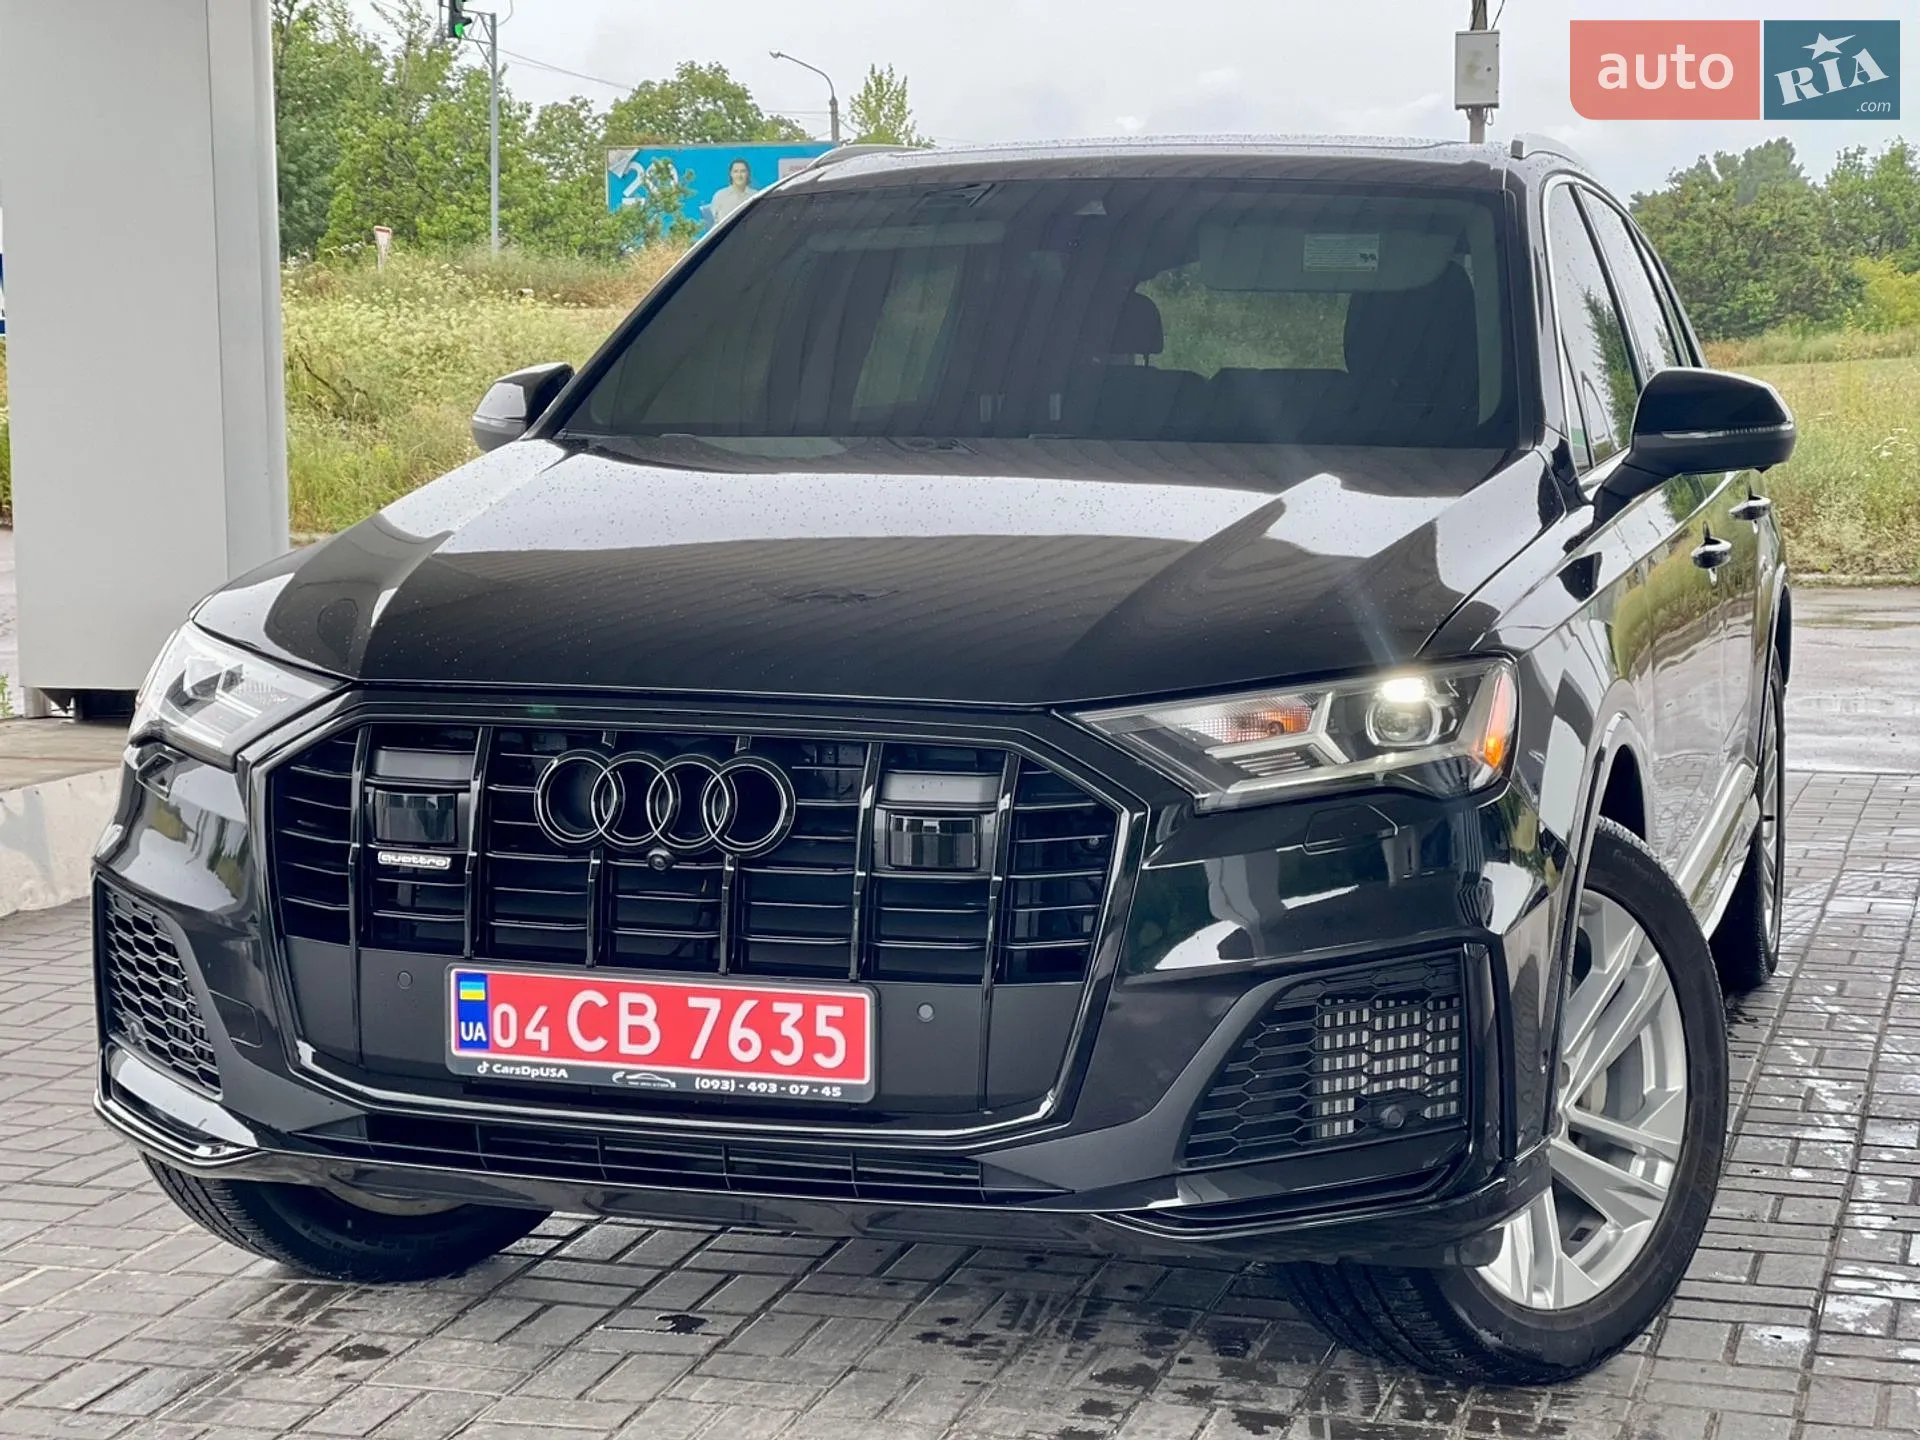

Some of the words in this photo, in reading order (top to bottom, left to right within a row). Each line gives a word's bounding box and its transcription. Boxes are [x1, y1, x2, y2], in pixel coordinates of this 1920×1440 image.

[381, 853, 448, 867] quattro
[460, 1021, 487, 1042] UA
[493, 1003, 550, 1052] 04
[567, 990, 661, 1056] CB
[687, 997, 847, 1069] 7635
[695, 1077, 735, 1091] (093)
[747, 1081, 778, 1093] 493
[789, 1084, 809, 1095] 07
[821, 1086, 842, 1097] 45
